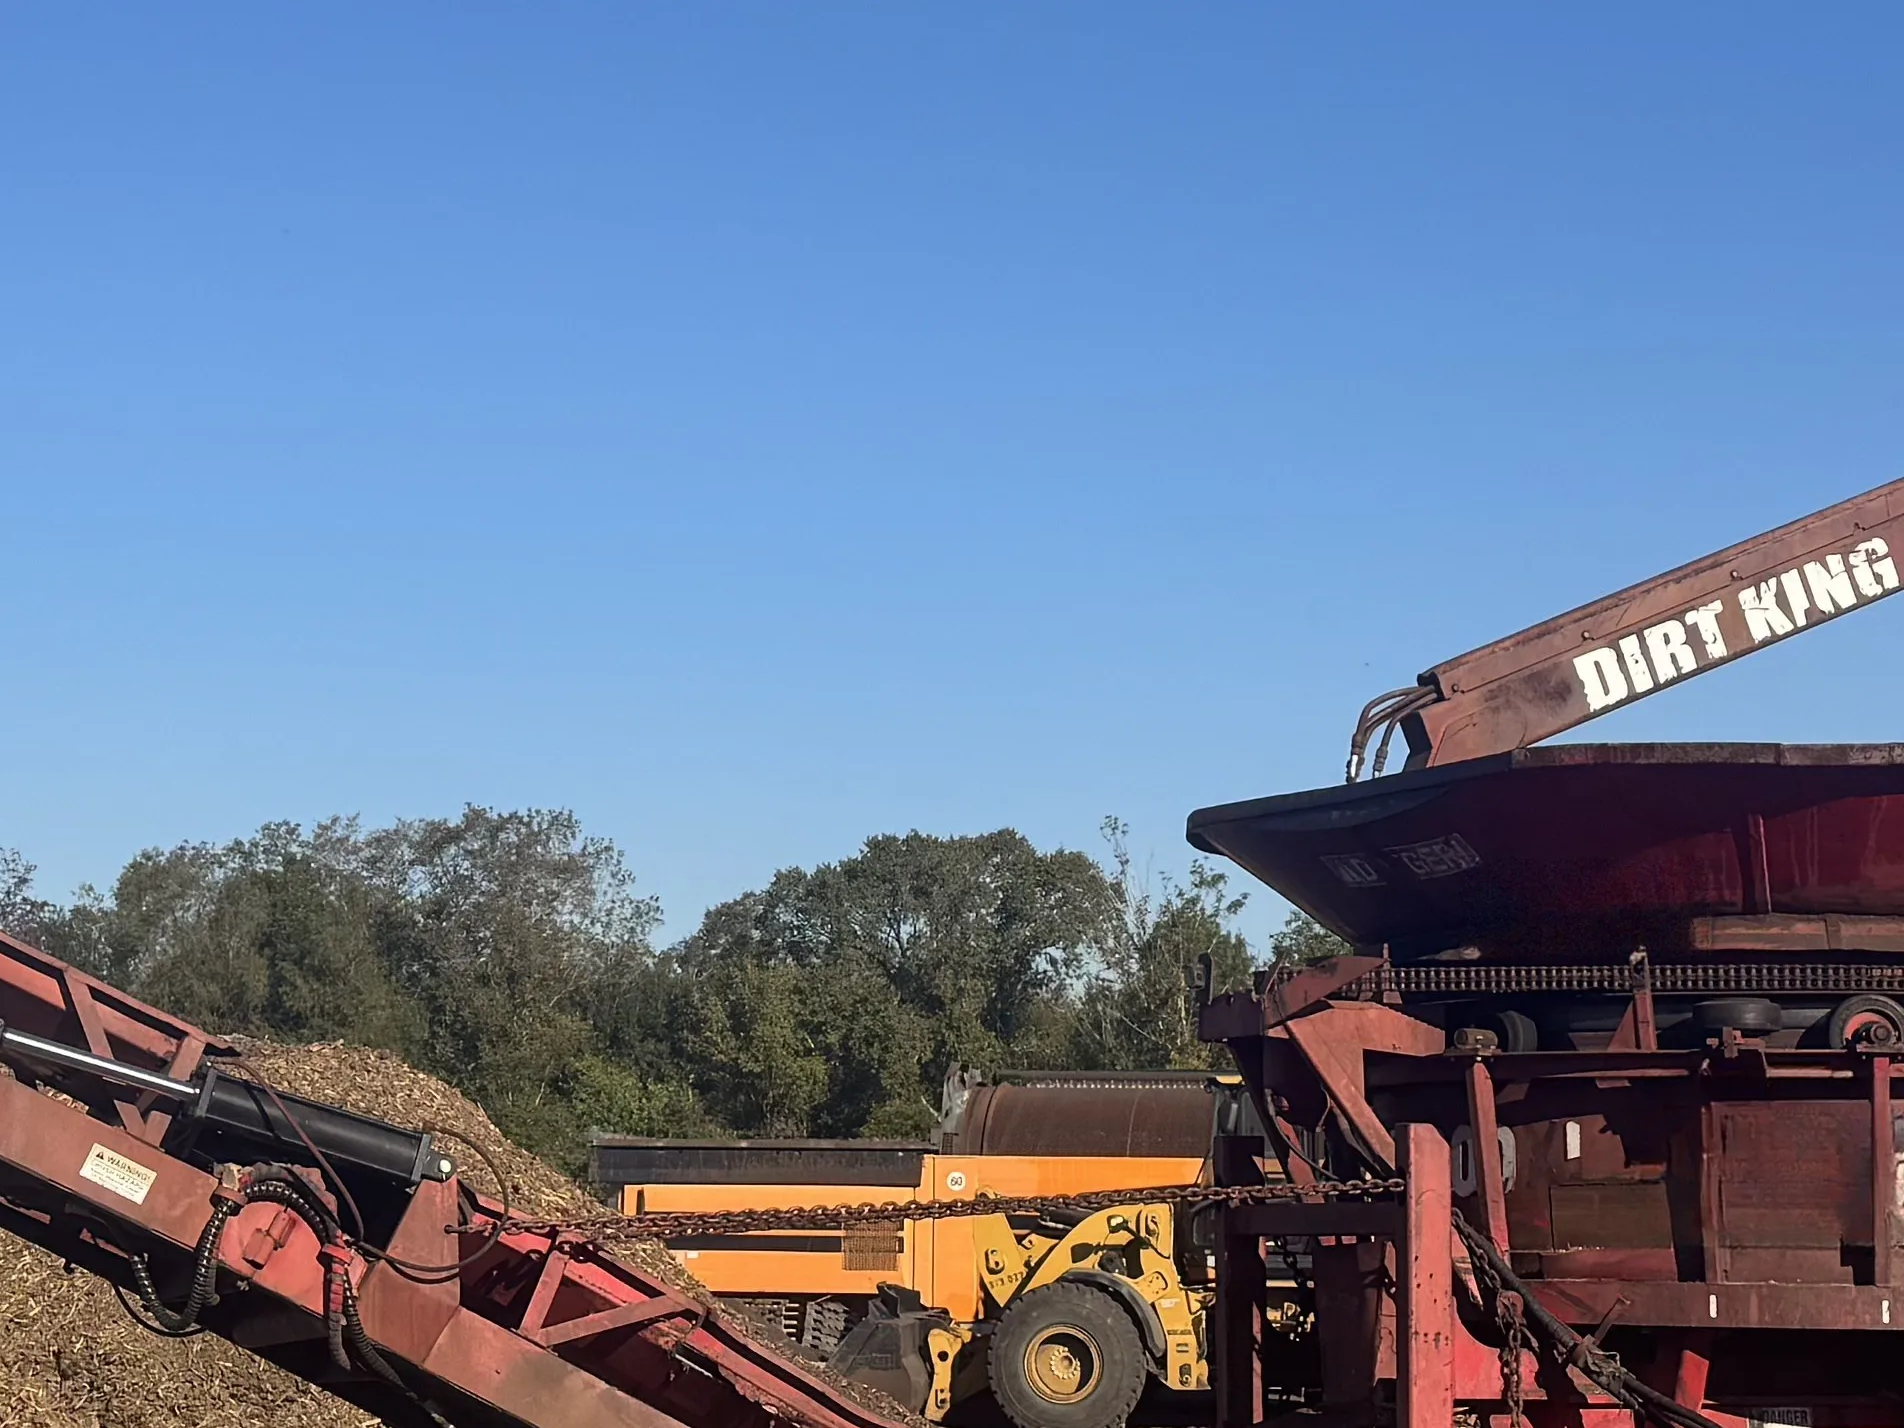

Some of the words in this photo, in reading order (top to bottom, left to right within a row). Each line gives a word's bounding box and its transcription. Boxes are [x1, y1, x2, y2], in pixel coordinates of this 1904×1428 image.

[1573, 599, 1728, 712] DIRT
[1737, 537, 1900, 645] KING
[950, 1176, 963, 1186] 60
